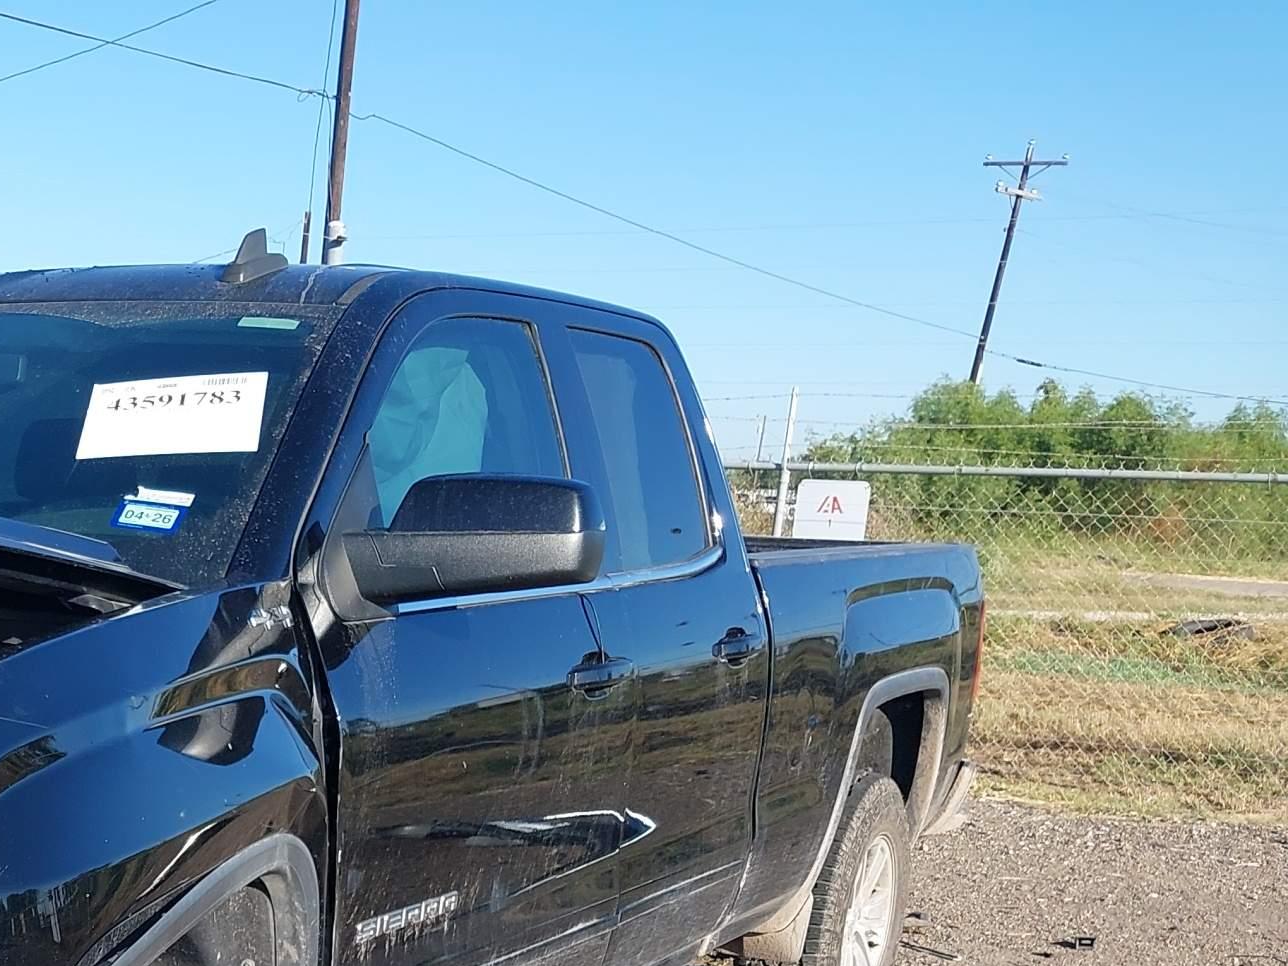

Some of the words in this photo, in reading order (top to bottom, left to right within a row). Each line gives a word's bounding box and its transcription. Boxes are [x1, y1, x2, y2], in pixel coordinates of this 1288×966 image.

[107, 389, 241, 412] 43591783
[124, 509, 145, 520] 04
[151, 512, 174, 524] 26
